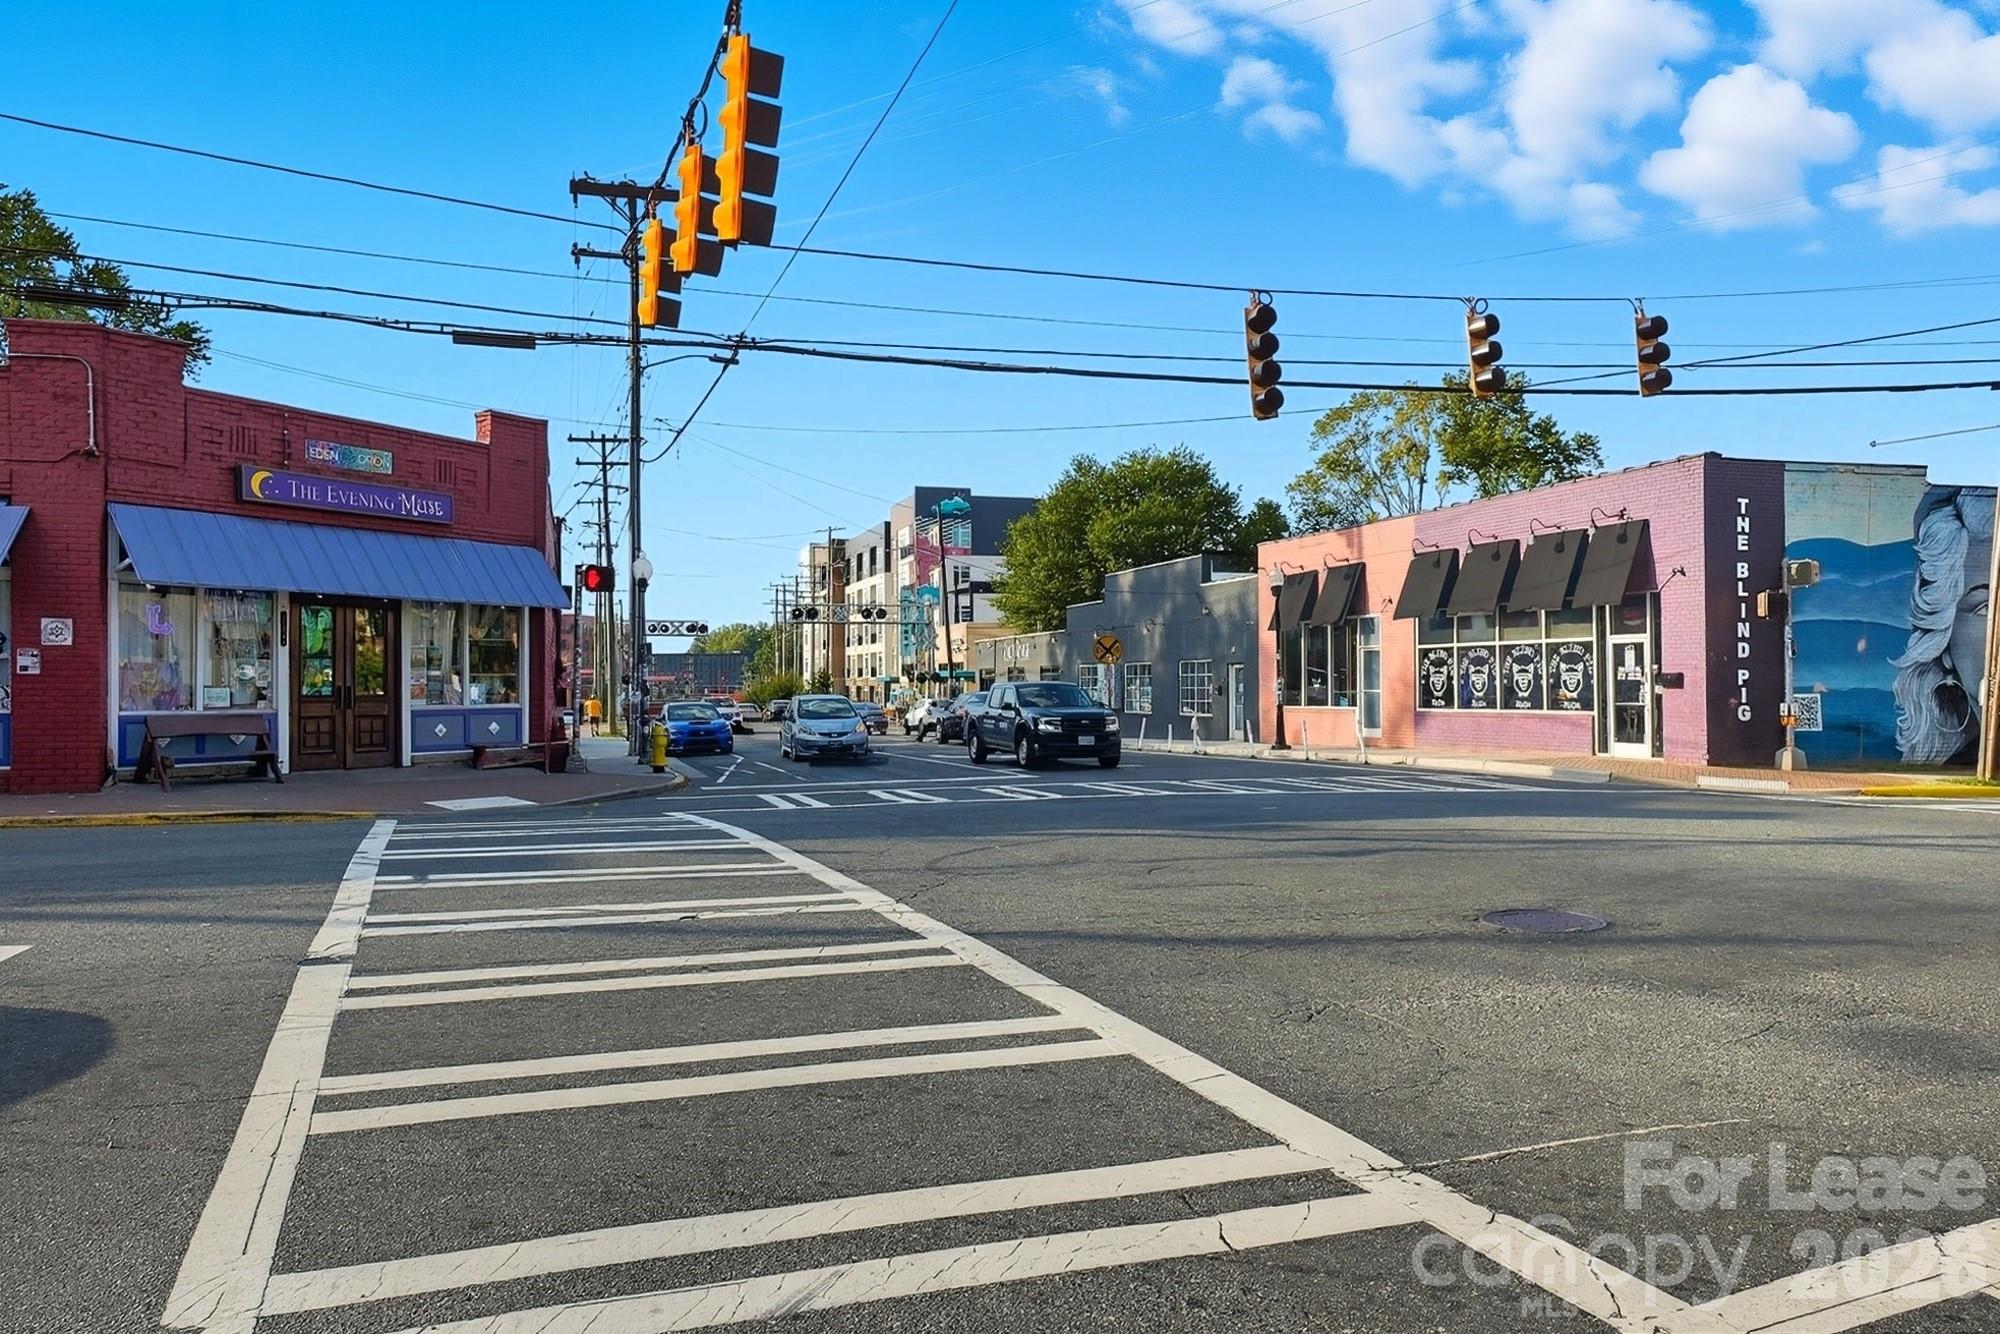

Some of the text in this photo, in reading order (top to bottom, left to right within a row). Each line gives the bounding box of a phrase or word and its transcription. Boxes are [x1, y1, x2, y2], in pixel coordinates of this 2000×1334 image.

[287, 480, 320, 501] THE
[327, 485, 395, 511] EVENING
[1737, 562, 1750, 659] BLIND
[1737, 669, 1752, 722] PIG
